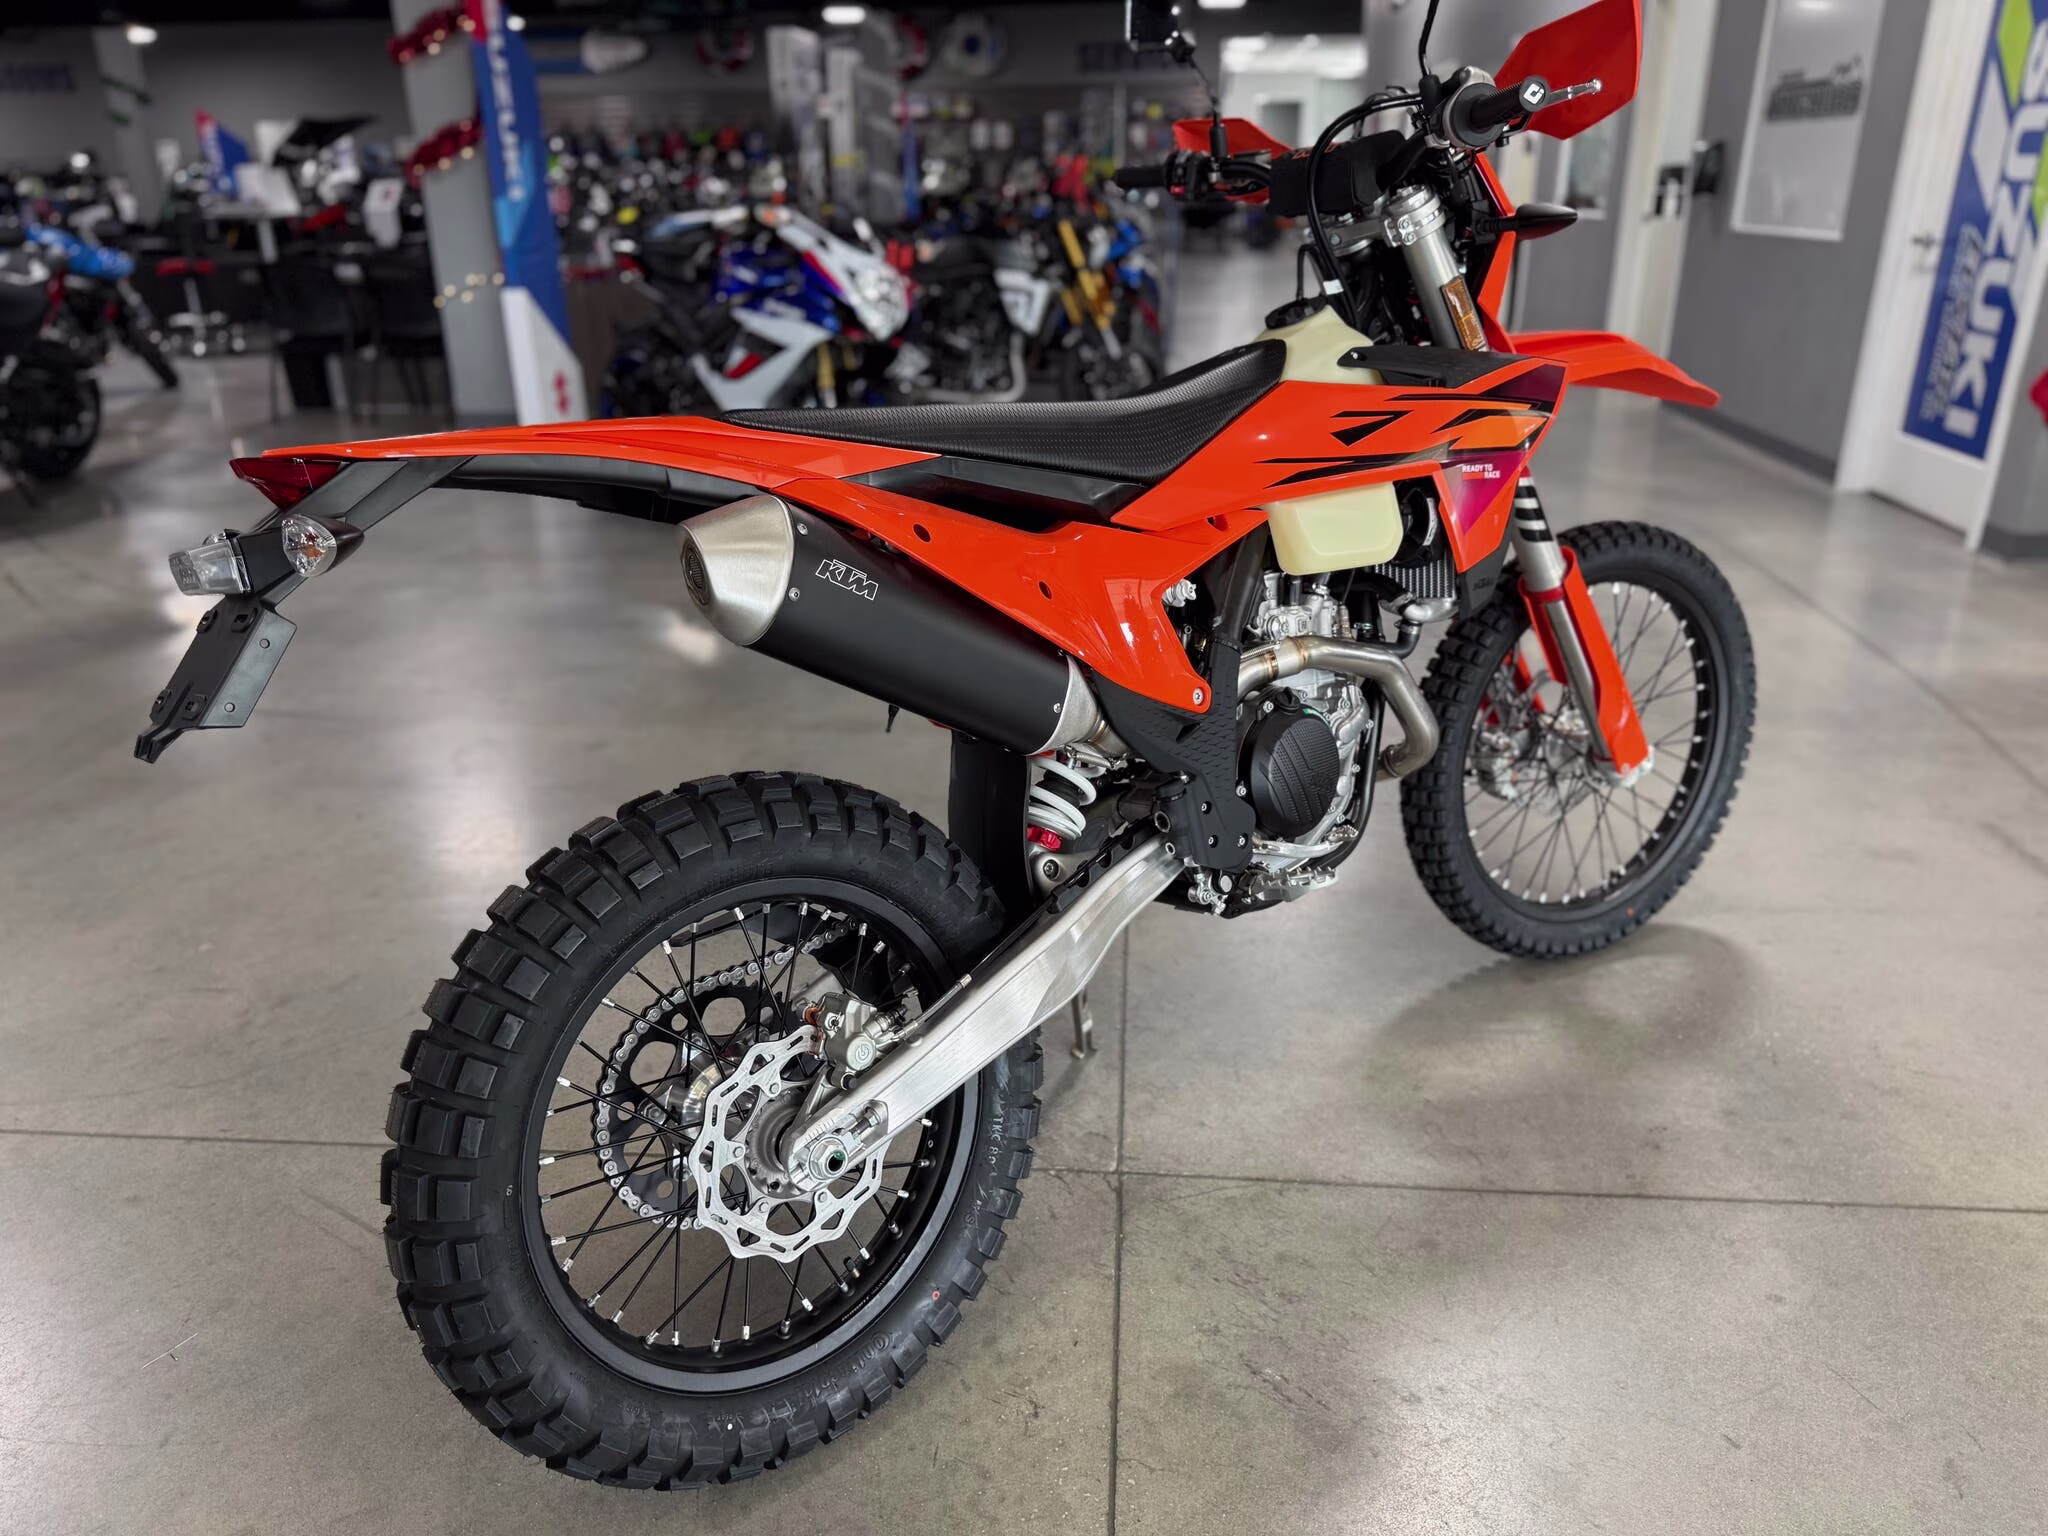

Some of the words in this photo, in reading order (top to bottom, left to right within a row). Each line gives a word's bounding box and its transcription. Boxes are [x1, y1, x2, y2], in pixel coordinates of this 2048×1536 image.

[1943, 20, 2048, 438] SUZUKI
[1484, 470, 1500, 478] RACE
[816, 559, 878, 600] KTM
[991, 1117, 1004, 1141] TKC
